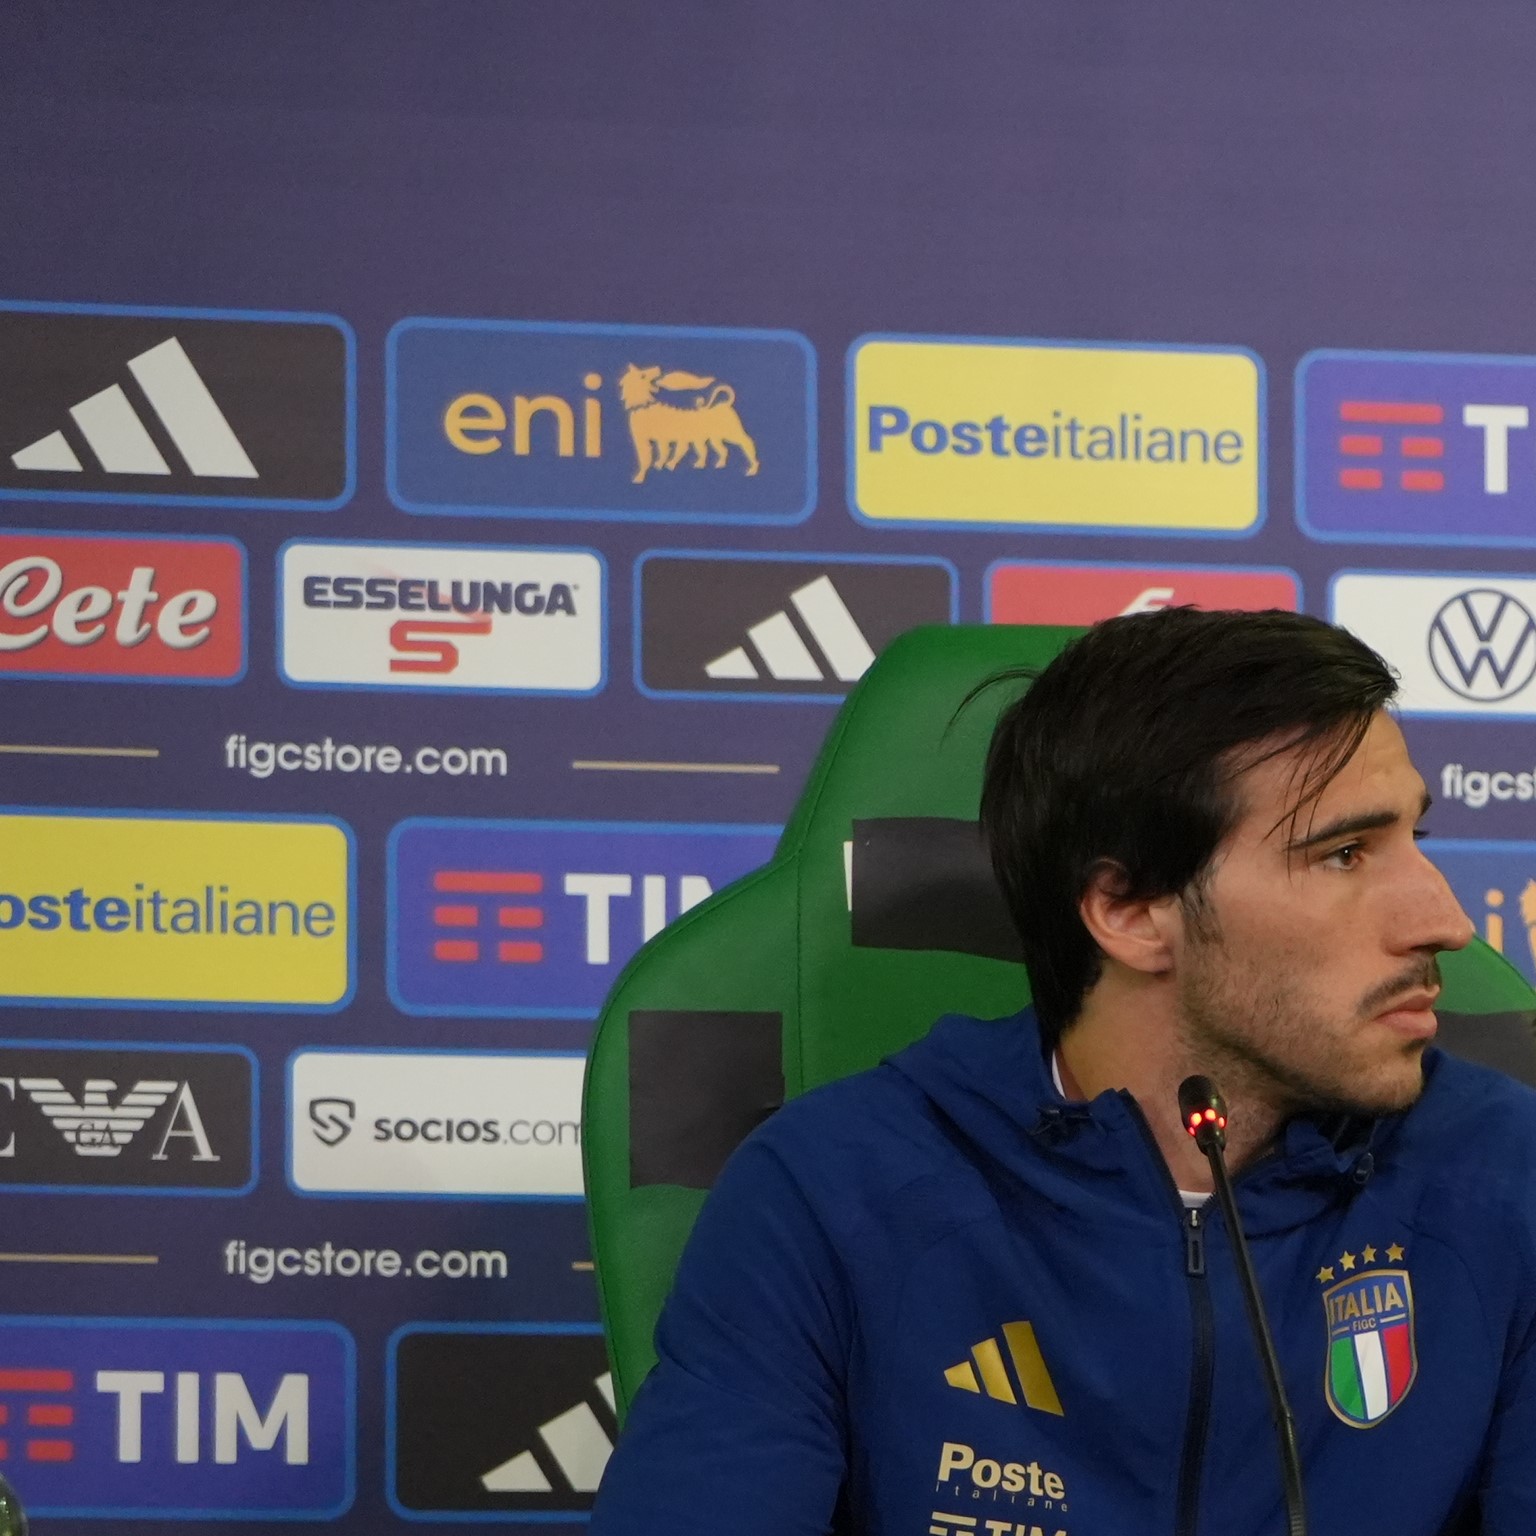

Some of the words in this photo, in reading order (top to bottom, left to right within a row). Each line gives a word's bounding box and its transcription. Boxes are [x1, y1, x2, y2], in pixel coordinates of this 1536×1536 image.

[443, 372, 603, 458] eni
[868, 404, 1243, 465] Posteitaliane
[302, 575, 575, 616] ESSELUNGA
[225, 734, 508, 779] figcstore.com
[224, 1239, 508, 1284] figcstore.com
[1329, 1282, 1404, 1325] ITALIA
[95, 1370, 309, 1465] TIM
[938, 1442, 1065, 1500] Poste
